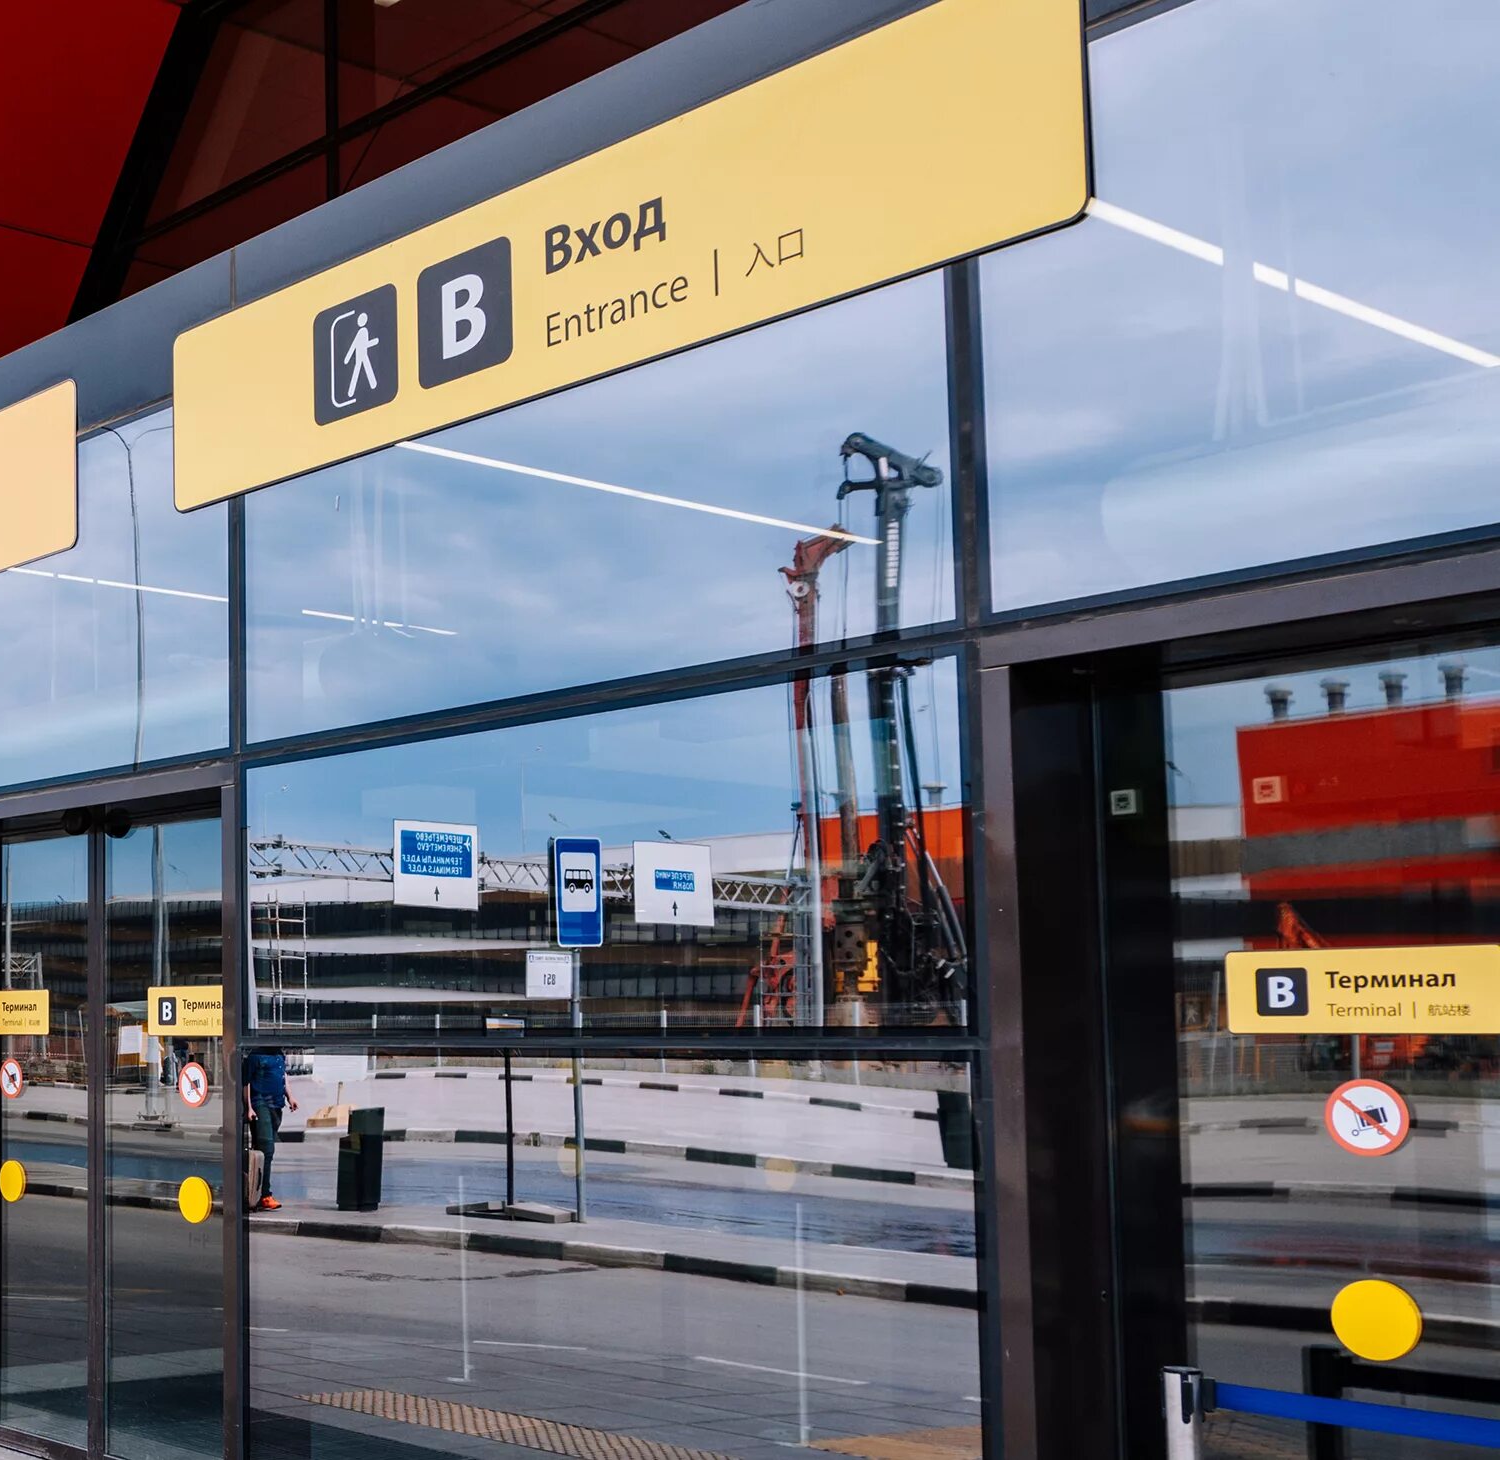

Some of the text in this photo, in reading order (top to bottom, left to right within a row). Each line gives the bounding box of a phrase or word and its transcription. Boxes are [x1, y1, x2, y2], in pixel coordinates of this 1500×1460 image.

[545, 196, 666, 275] Вход
[745, 228, 804, 278] 入口
[441, 273, 486, 360] B
[546, 275, 688, 348] Entrance
[1267, 976, 1296, 1008] B
[1325, 971, 1456, 993] Терминал
[2, 1002, 37, 1013] Терминал
[162, 1001, 173, 1021] B
[182, 999, 222, 1012] Термина
[1327, 1002, 1402, 1017] Terminal
[1427, 1004, 1471, 1017] 航站楼
[2, 1018, 22, 1026] Terminal
[182, 1017, 208, 1026] Terminal
